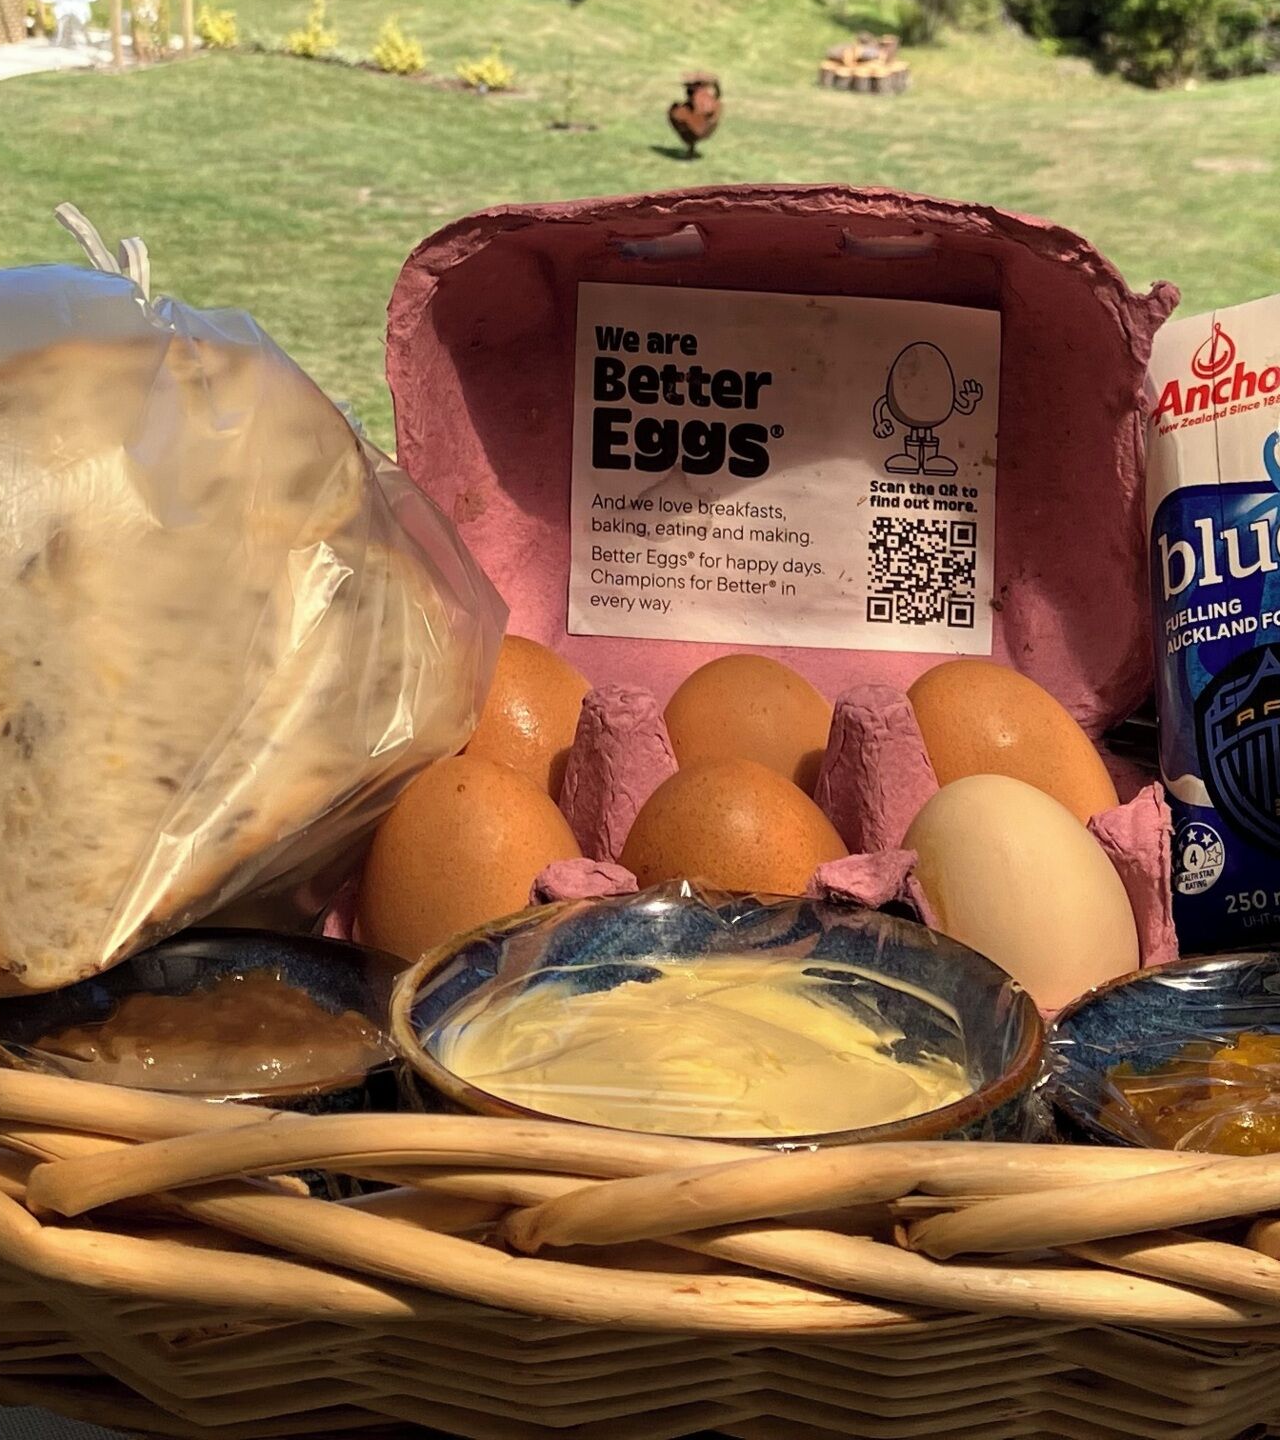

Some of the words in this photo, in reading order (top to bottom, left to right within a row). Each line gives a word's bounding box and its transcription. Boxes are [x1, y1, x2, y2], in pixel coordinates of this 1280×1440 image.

[595, 326, 640, 353] We
[647, 332, 697, 356] are
[594, 356, 772, 409] Better
[1158, 421, 1179, 438] New
[1181, 409, 1227, 428] Zealand
[1229, 401, 1260, 415] Since
[870, 480, 905, 494] Scan
[909, 482, 935, 496] the
[938, 484, 958, 497] QR
[962, 486, 978, 498] to
[591, 493, 625, 510] And
[630, 498, 653, 512] we
[659, 496, 693, 514] love
[698, 499, 787, 522] breakfasts,
[870, 495, 900, 508] find
[903, 498, 930, 510] out
[933, 500, 978, 513] more.
[591, 517, 651, 537] baking,
[655, 522, 707, 541] eating
[712, 525, 744, 541] and
[749, 528, 814, 547] making.
[591, 545, 642, 564] Better
[699, 552, 722, 569] for
[726, 553, 778, 575] happy
[783, 558, 826, 577] days.
[590, 568, 686, 591] Champions
[690, 574, 713, 591] for
[781, 581, 796, 596] in
[590, 594, 636, 612] every
[639, 597, 673, 614] way.
[1165, 598, 1242, 636] FUELLING
[1167, 616, 1257, 657] AUCKLAND
[1189, 850, 1198, 866] 4
[1225, 890, 1267, 914] 250
